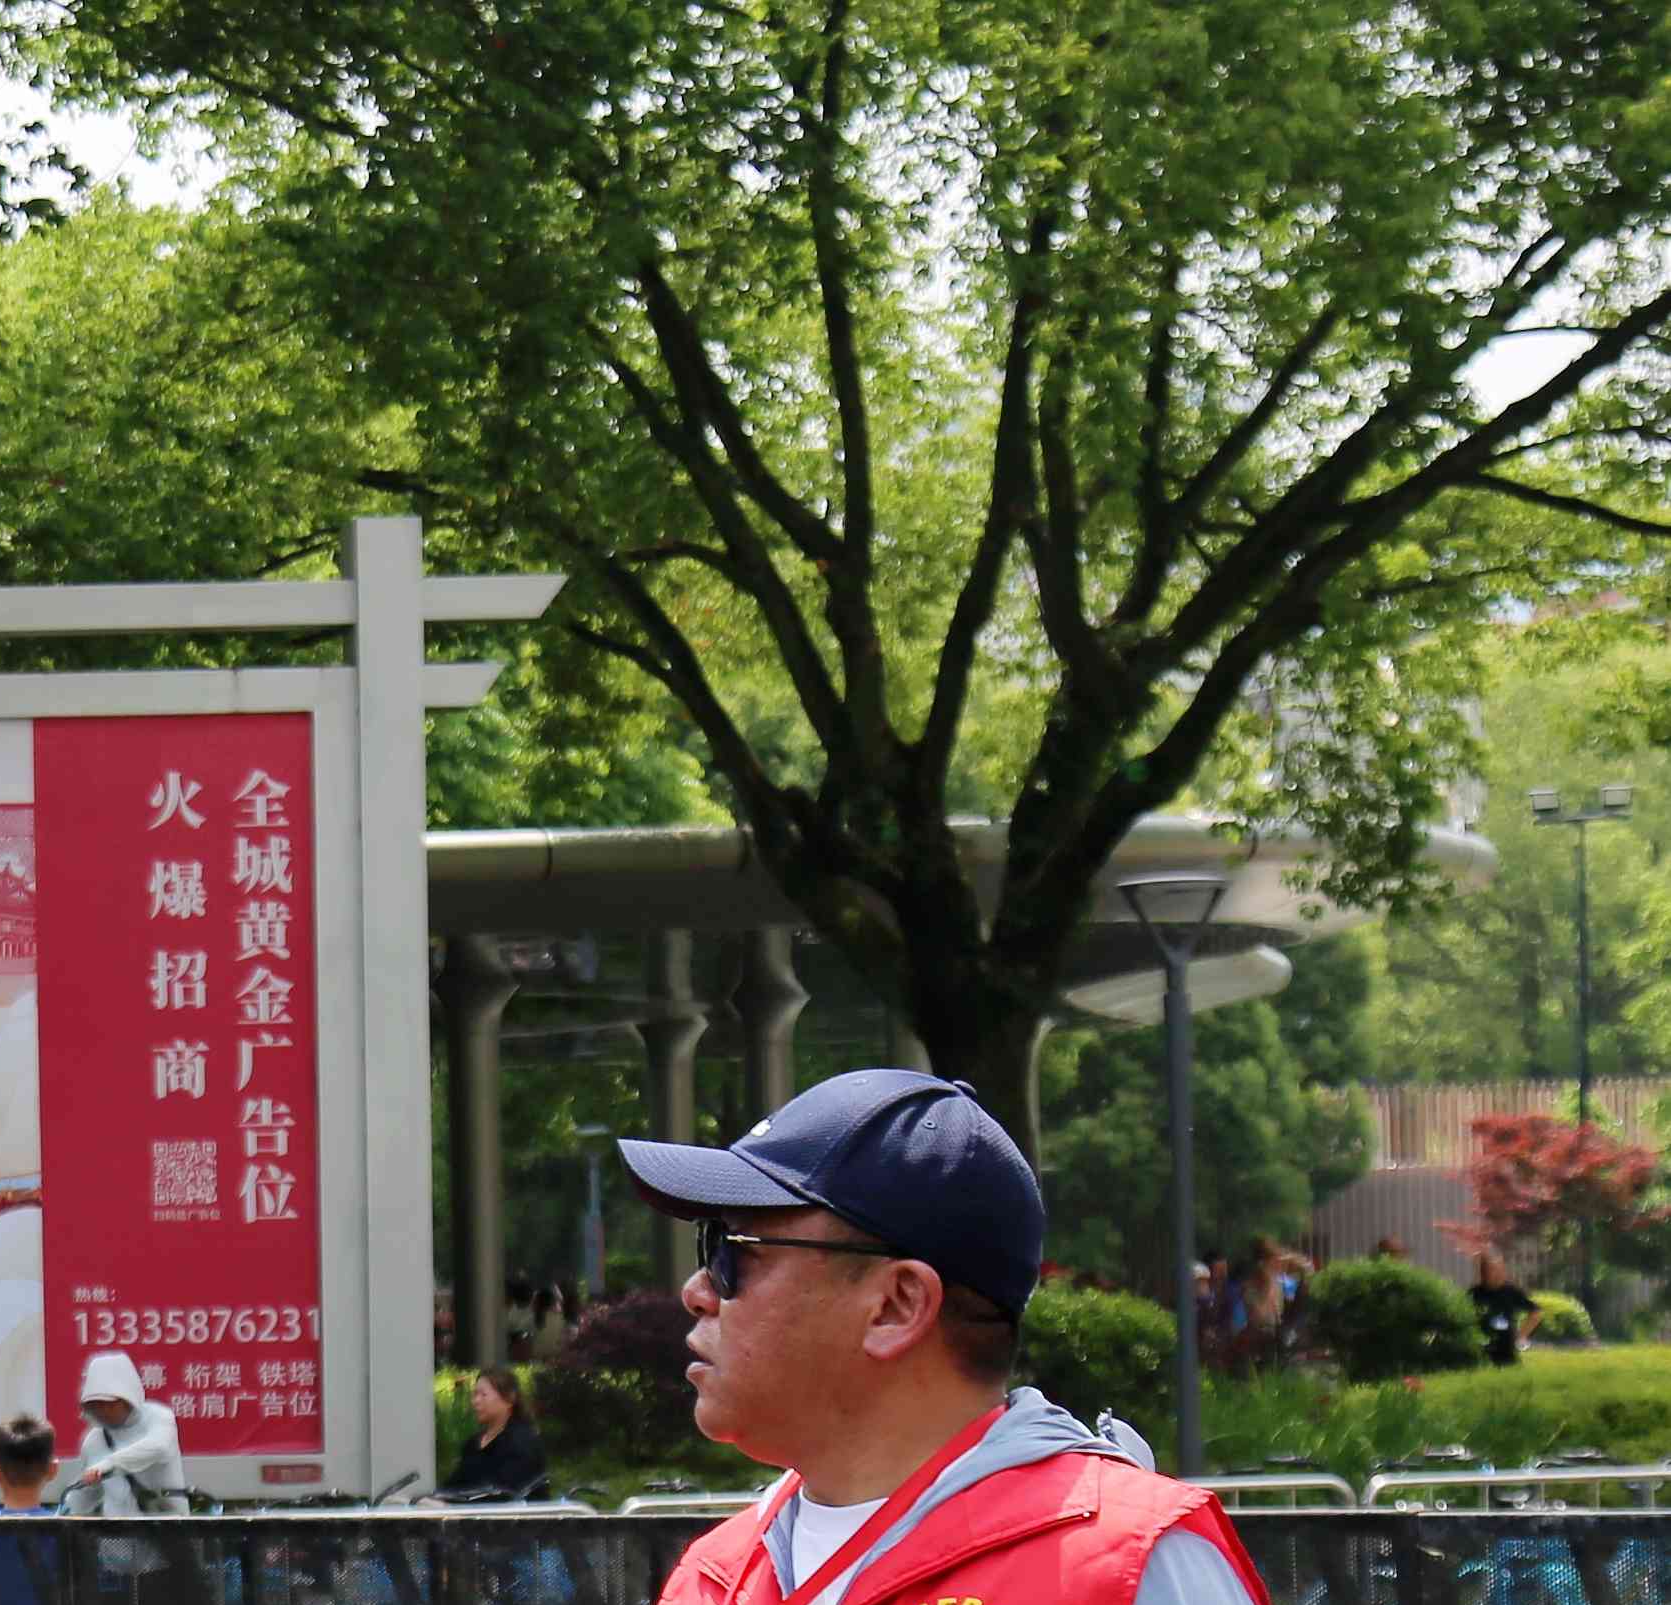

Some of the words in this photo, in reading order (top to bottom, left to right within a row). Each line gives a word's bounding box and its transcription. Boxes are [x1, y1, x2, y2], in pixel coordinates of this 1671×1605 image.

[147, 769, 210, 1100] 火爆招商
[232, 768, 299, 1225] 全城黄金广告位
[73, 1307, 321, 1346] 13335876231
[258, 1360, 317, 1387] 铁塔
